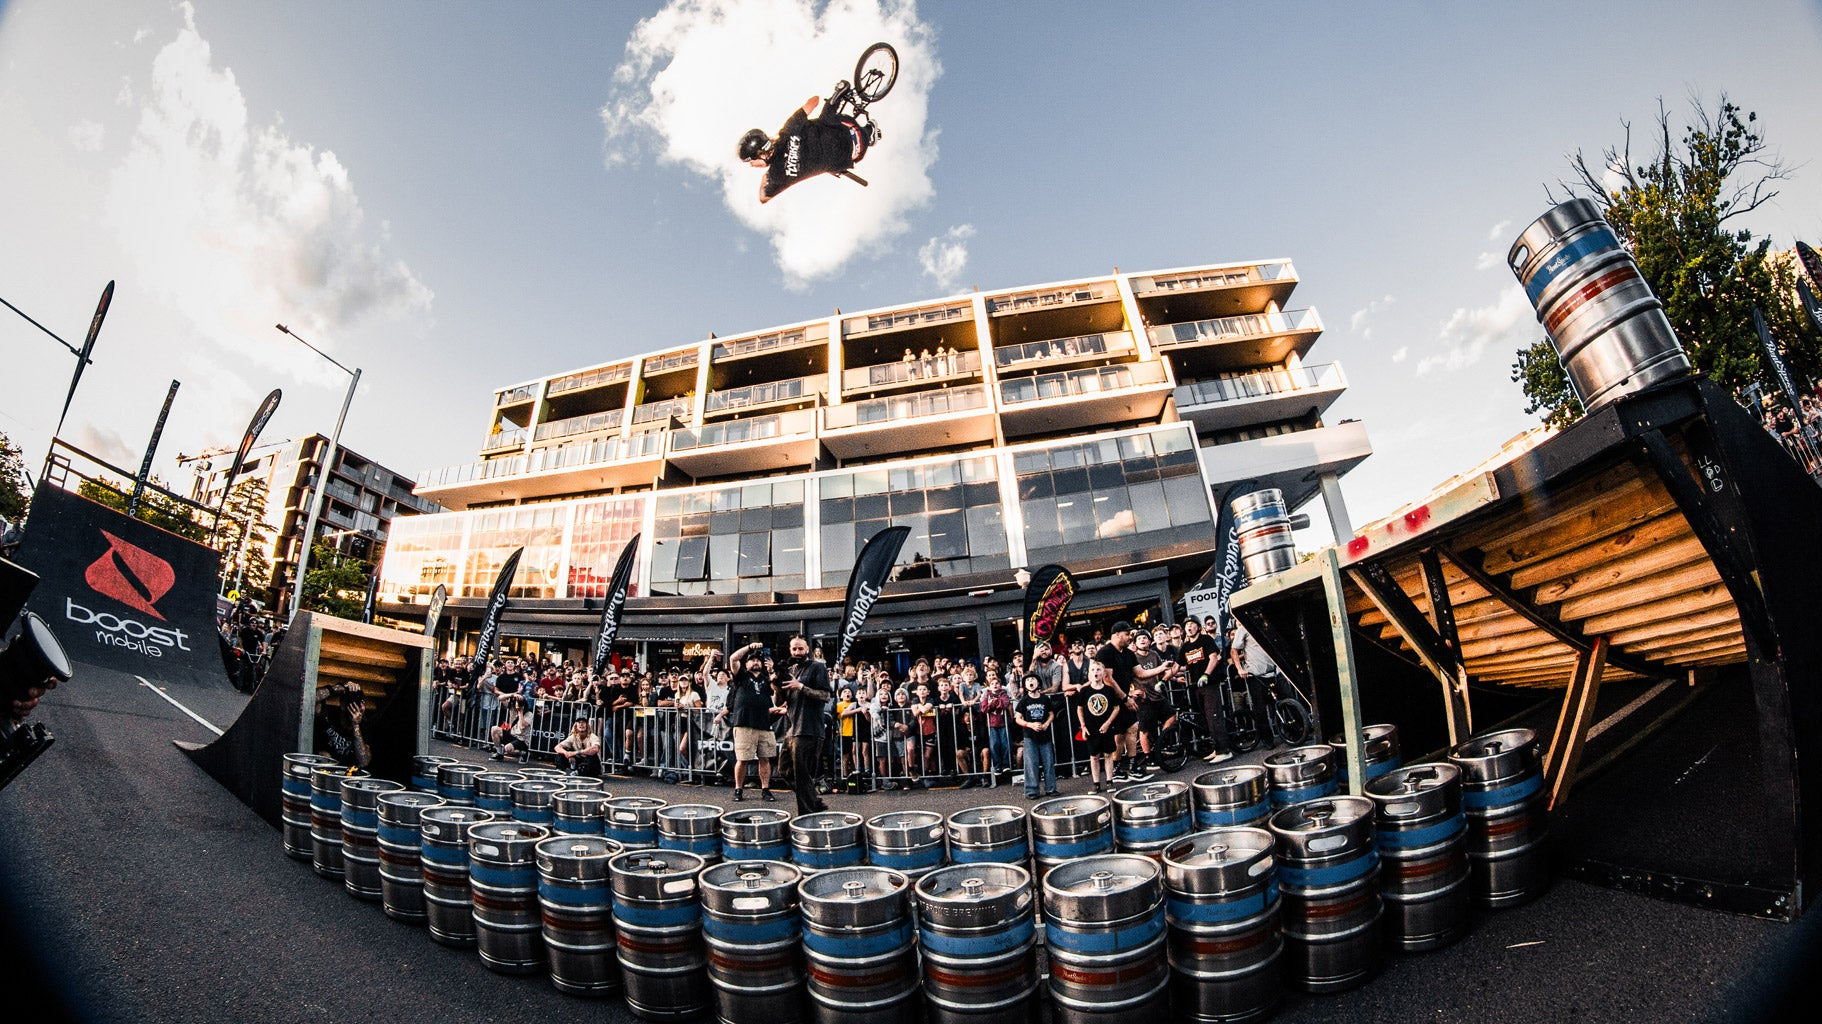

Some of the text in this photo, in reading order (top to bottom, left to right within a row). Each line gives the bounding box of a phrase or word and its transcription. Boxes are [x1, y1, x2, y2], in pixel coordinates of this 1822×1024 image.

[1190, 592, 1217, 604] FOOD
[66, 597, 191, 651] boost
[598, 588, 626, 664] BentSpo
[96, 631, 162, 657] mobile
[698, 740, 734, 751] PRO
